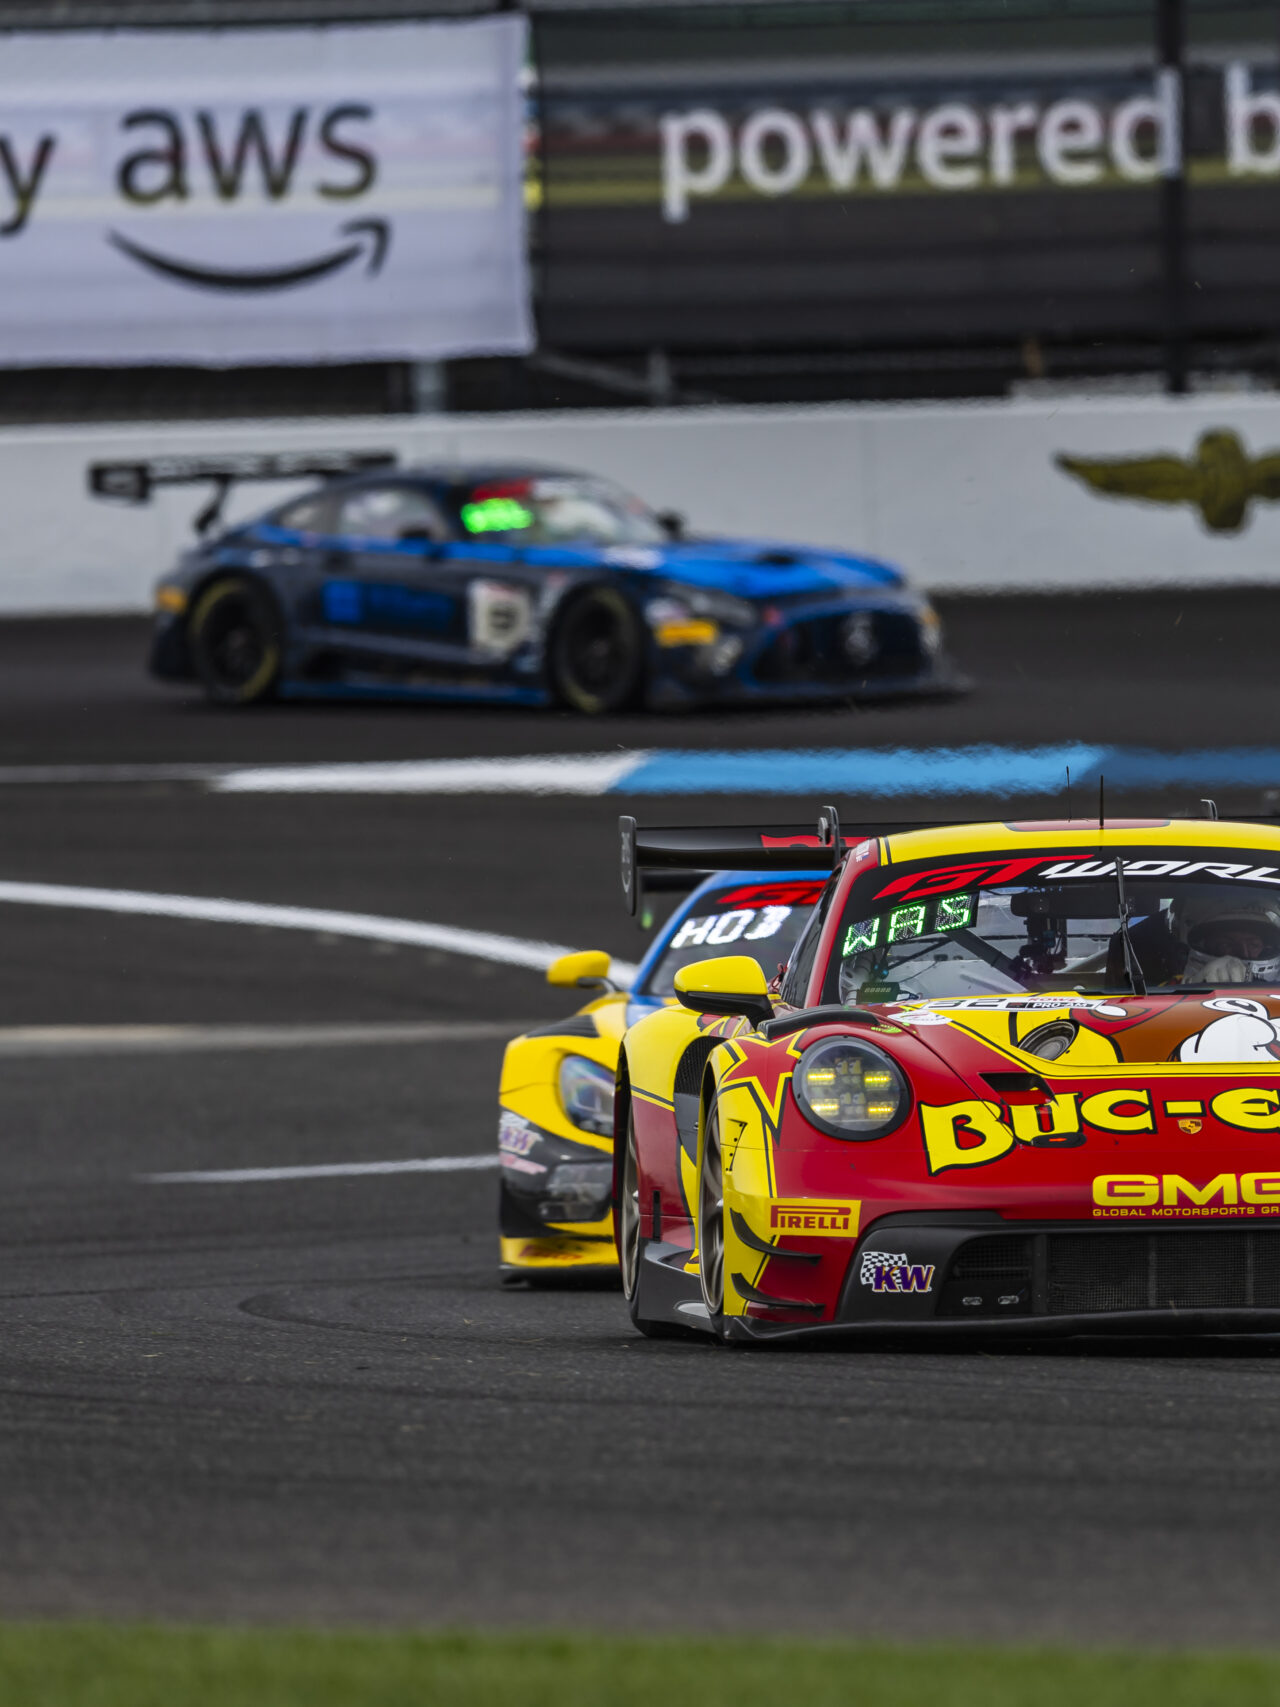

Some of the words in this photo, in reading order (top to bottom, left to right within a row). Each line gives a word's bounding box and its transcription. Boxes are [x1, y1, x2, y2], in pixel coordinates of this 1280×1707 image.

[116, 103, 378, 205] aws
[660, 66, 1182, 223] powered
[872, 854, 1094, 901] GT
[842, 894, 972, 957] WAS
[1032, 1002, 1087, 1010] PRO-AM
[770, 1205, 852, 1230] PIRELLI
[1092, 1208, 1147, 1217] GLOBAL
[1151, 1206, 1256, 1217] MOTORSPORTS
[872, 1265, 936, 1293] KW
